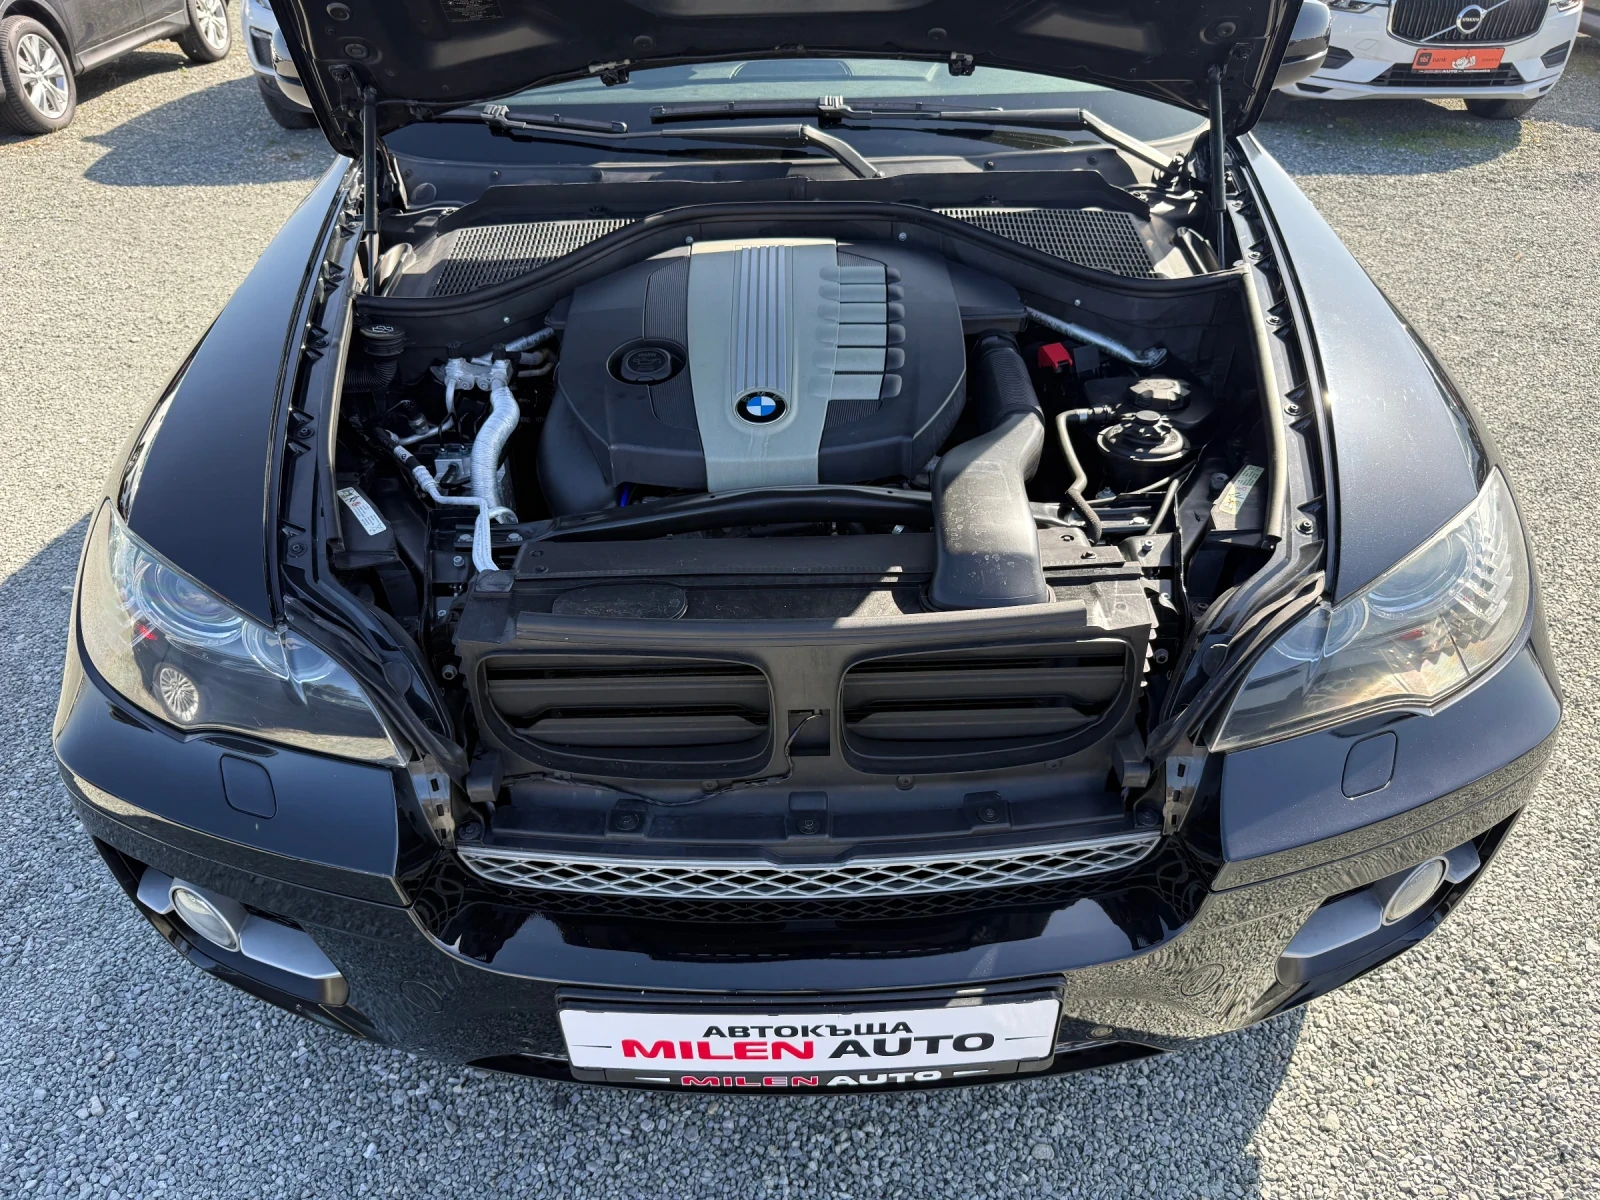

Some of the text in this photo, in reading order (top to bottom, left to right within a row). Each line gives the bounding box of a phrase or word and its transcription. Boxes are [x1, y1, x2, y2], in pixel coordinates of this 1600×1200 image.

[621, 1032, 995, 1060] MILEN AUTO
[681, 1070, 942, 1087] MILEN AUTO
